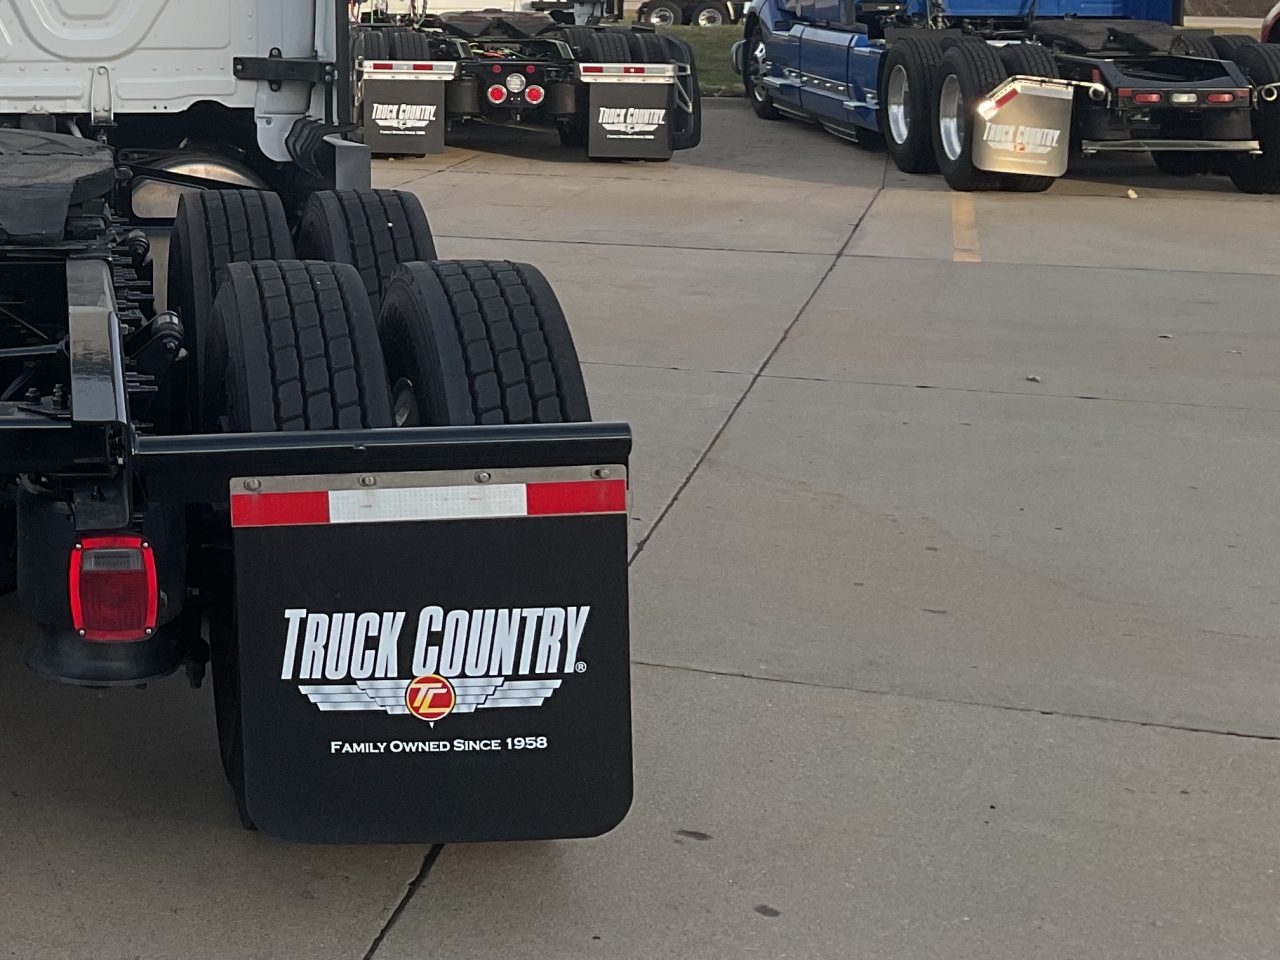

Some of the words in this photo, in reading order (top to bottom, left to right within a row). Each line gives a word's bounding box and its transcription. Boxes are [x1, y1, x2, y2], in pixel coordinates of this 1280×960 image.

[371, 103, 399, 120] TRUCK
[598, 107, 627, 123] TRUCK
[280, 608, 406, 680] TRUCK
[330, 741, 387, 754] FAMILY
[389, 740, 450, 753] OWNED
[453, 738, 501, 751] SINCE
[505, 736, 548, 750] 1958
